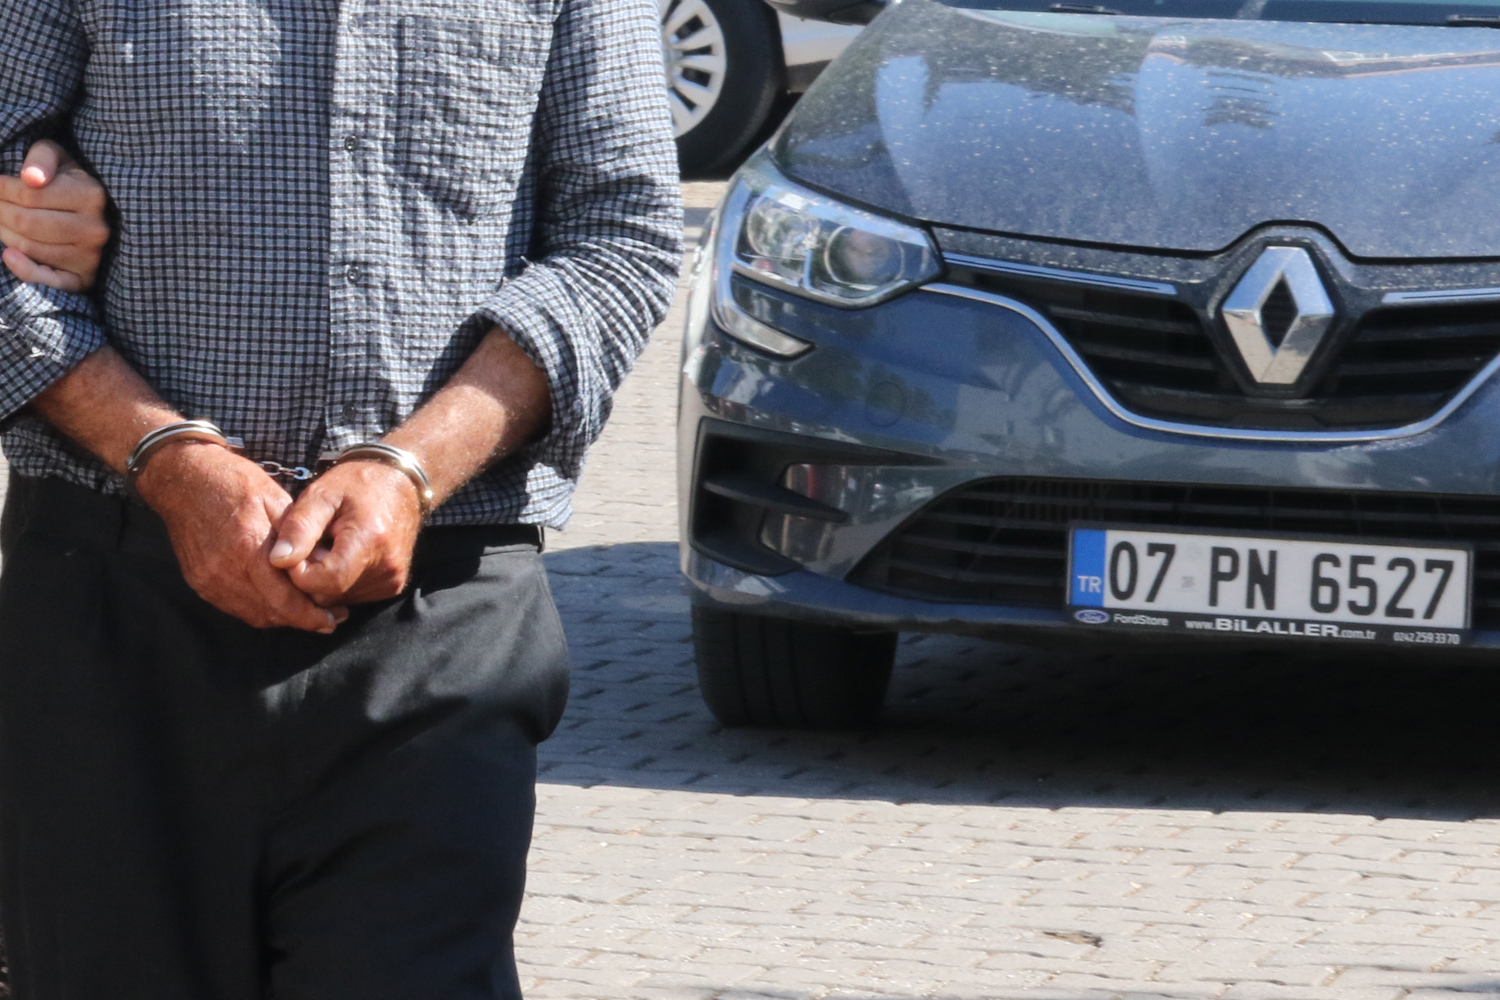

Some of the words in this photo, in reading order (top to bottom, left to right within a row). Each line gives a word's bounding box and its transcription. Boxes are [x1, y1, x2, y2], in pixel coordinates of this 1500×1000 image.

[1077, 575, 1102, 593] TR
[1109, 541, 1177, 603] 07
[1208, 546, 1278, 611] PN
[1309, 553, 1455, 621] 6527
[1113, 612, 1169, 627] FordStore
